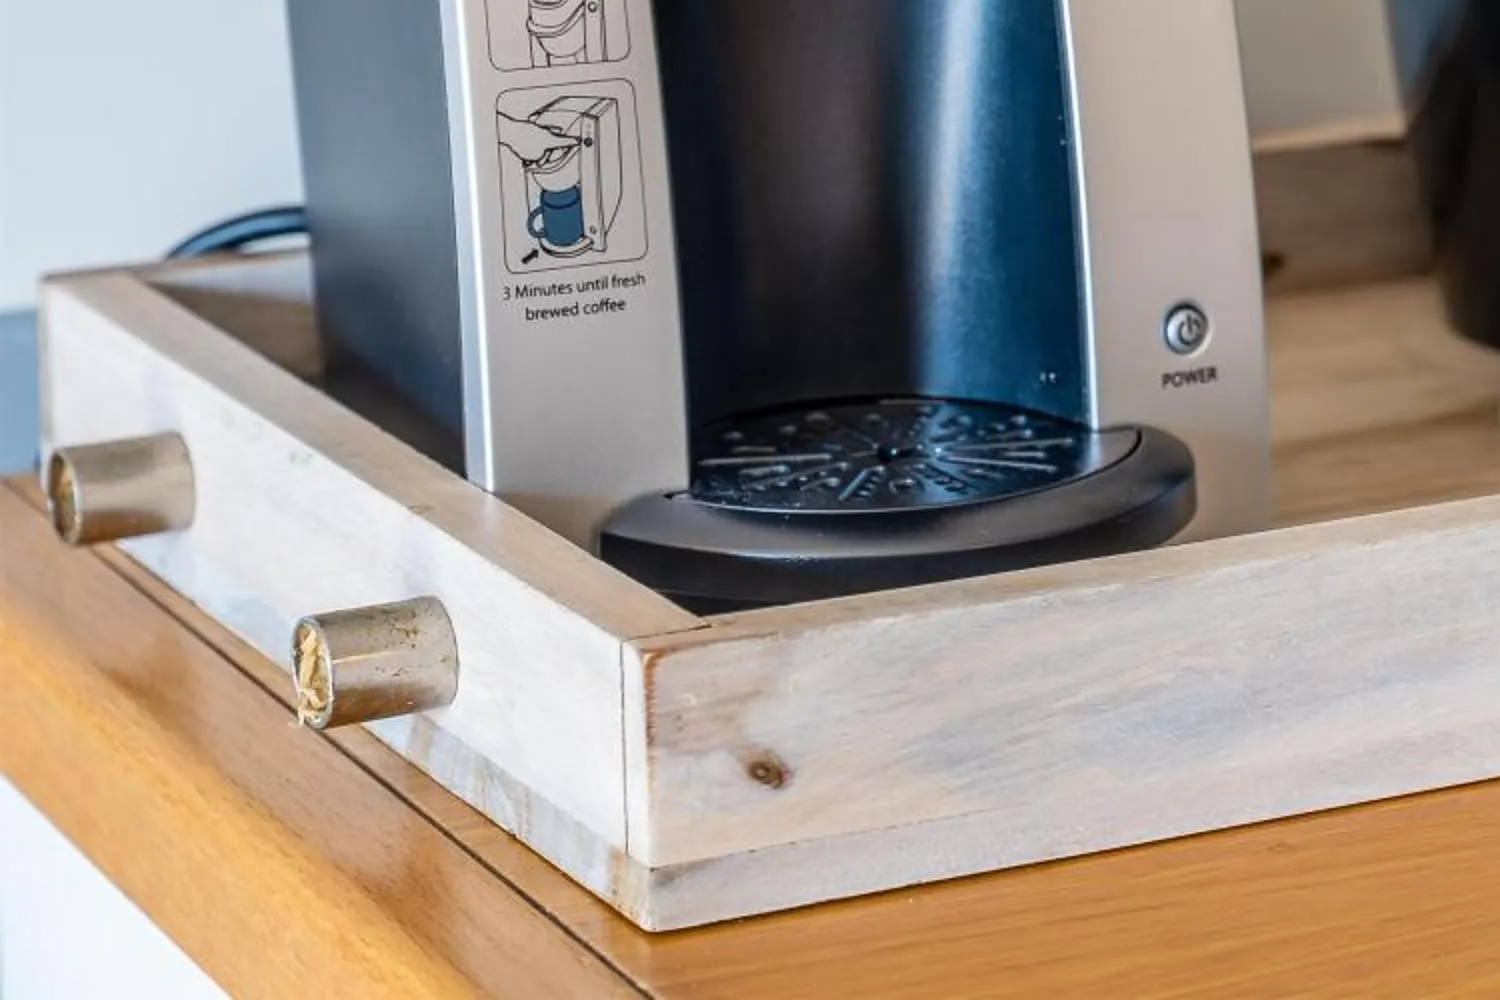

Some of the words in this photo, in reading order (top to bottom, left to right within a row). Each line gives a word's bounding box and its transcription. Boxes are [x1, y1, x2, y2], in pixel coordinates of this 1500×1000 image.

[503, 286, 511, 300] 3
[515, 283, 573, 299] Minutes
[577, 276, 609, 293] until
[612, 273, 645, 289] fresh
[525, 302, 579, 321] brewed
[583, 298, 626, 316] coffee
[1162, 367, 1217, 389] POWER
